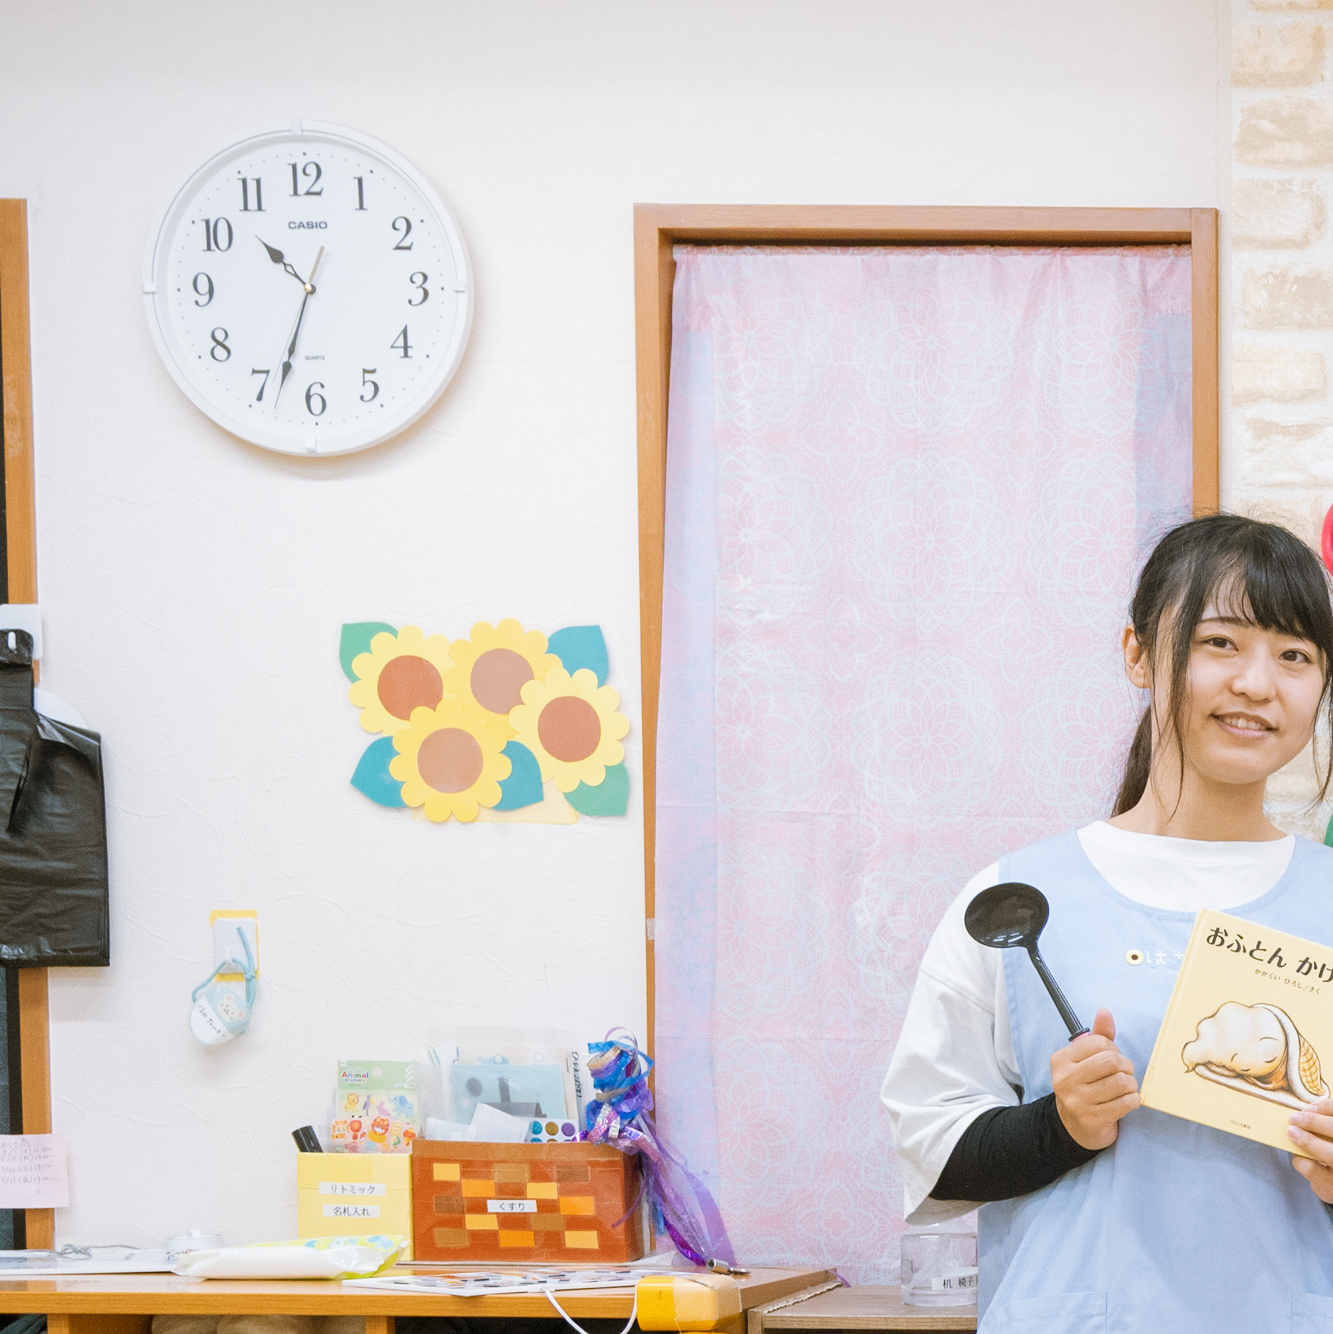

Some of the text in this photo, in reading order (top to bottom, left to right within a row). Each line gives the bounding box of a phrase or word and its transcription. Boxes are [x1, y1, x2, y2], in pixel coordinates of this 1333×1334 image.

[237, 175, 267, 213] 11
[287, 161, 324, 198] 12
[353, 175, 368, 212] 1
[201, 216, 234, 253] 10
[287, 220, 329, 231] CASIO
[391, 215, 414, 252] 2
[192, 272, 214, 307] 9
[408, 271, 430, 307] 3
[209, 326, 231, 362] 8
[390, 324, 413, 359] 4
[250, 368, 270, 402] 7
[305, 381, 327, 416] 6
[360, 368, 380, 402] 5
[1206, 926, 1287, 968] おふとん
[1254, 968, 1281, 982] かがくい
[330, 1184, 375, 1195] リトミック
[498, 1201, 525, 1212] くすり
[333, 1206, 370, 1217] 名札入れ
[943, 1276, 978, 1289] 机 椅子
